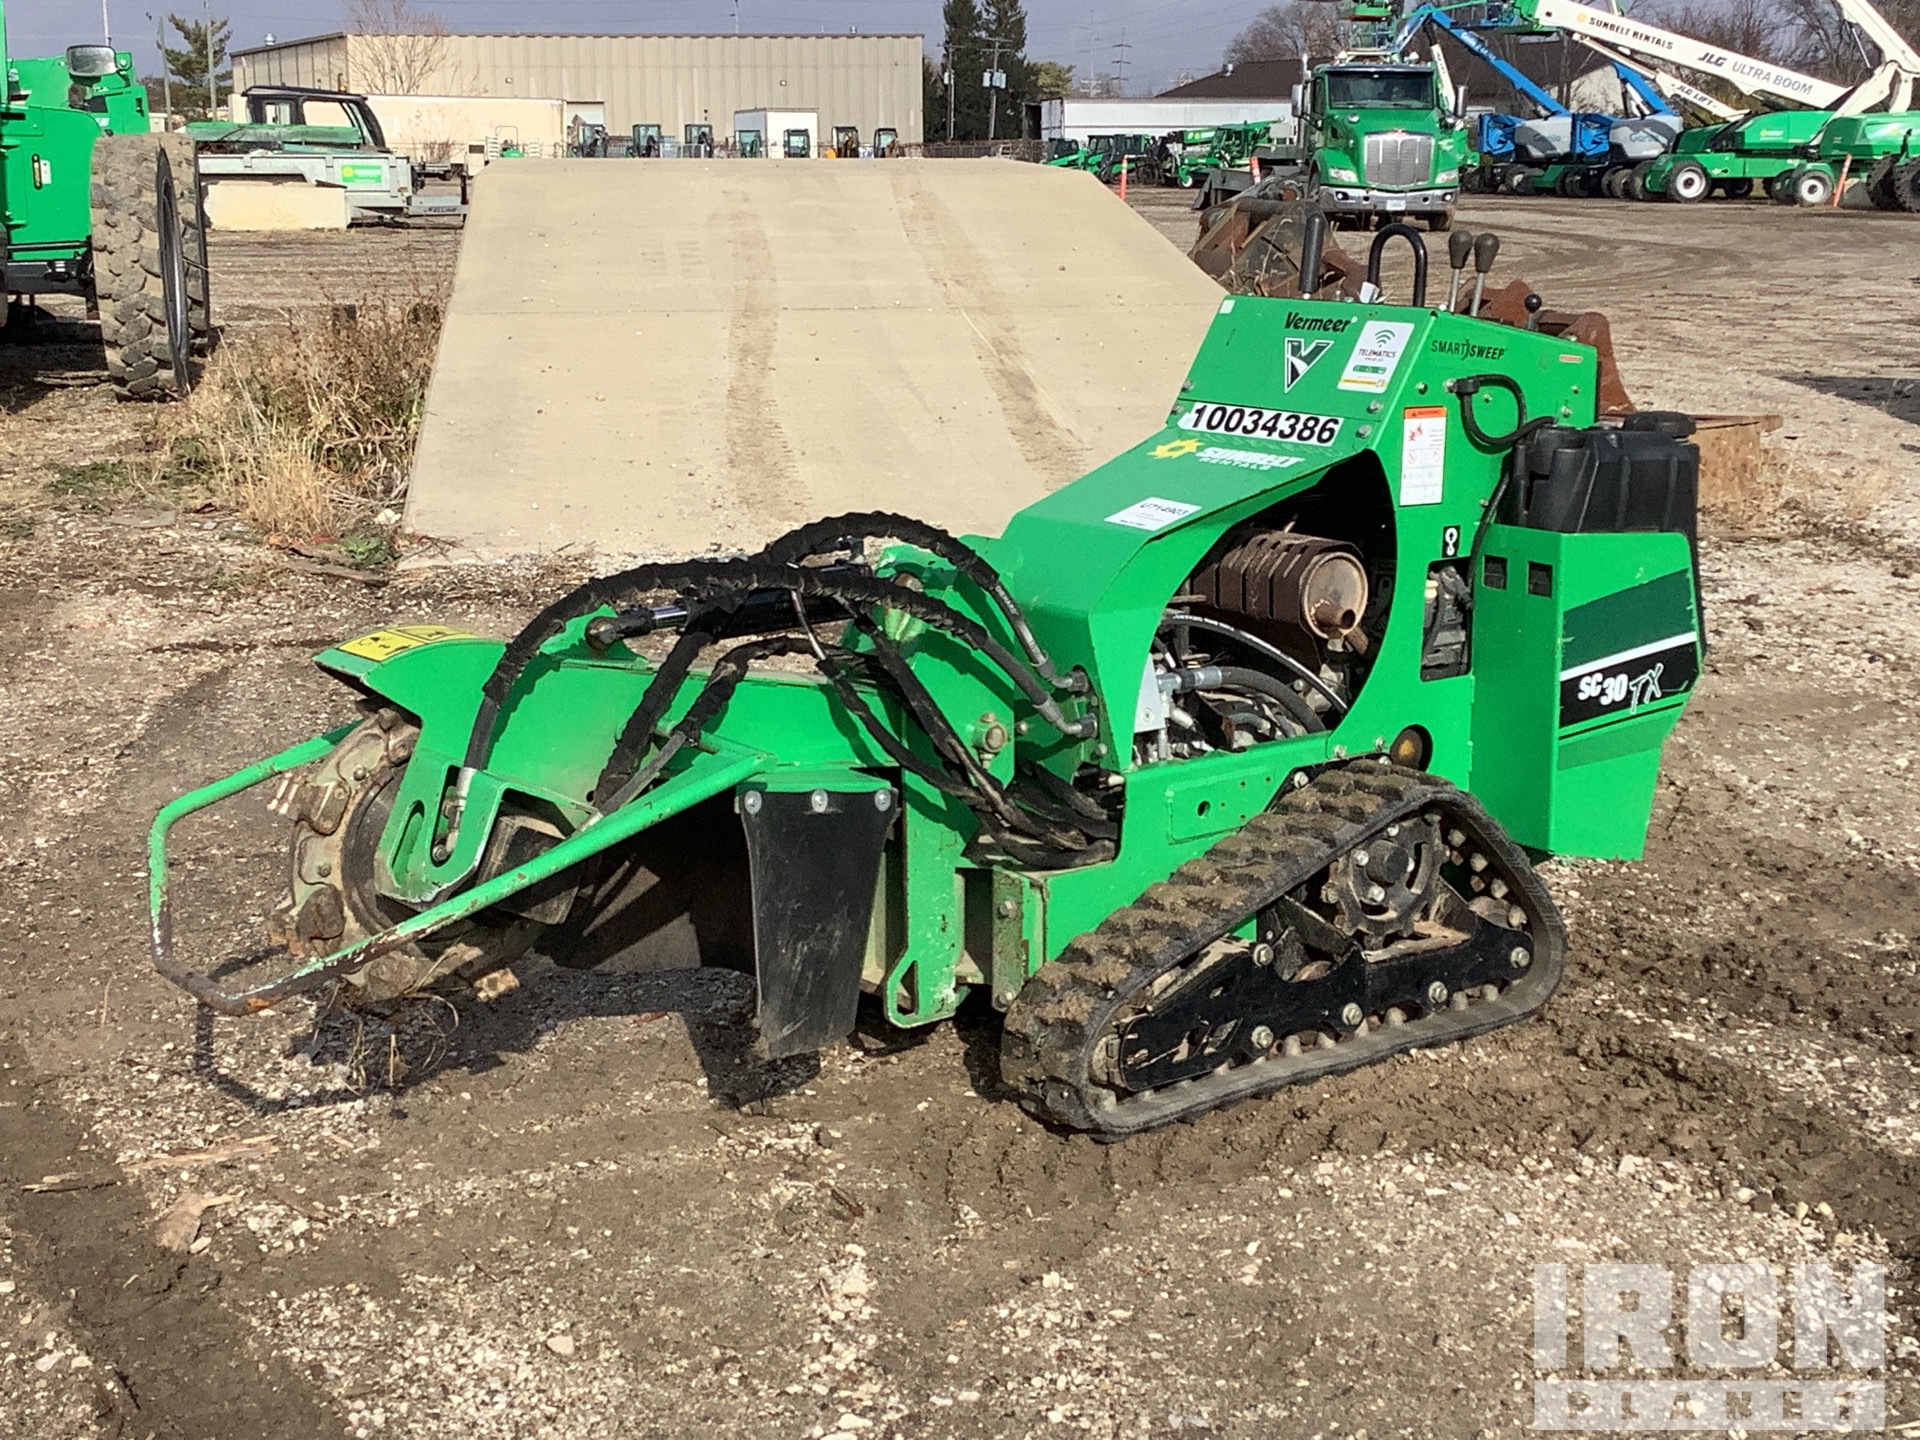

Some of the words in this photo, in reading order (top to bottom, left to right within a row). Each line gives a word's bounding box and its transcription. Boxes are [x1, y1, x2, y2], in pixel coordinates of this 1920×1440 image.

[1589, 17, 1631, 36] SUNBELT
[1632, 30, 1674, 50] RENTALS
[1697, 51, 1728, 68] JLG
[1732, 61, 1771, 84] ULTRA
[1773, 75, 1814, 96] BOOM
[1676, 84, 1694, 97] JLG
[1693, 92, 1714, 109] LIFT
[1284, 311, 1351, 333] Vermeer
[1359, 348, 1397, 358] TELEMATICS
[1431, 339, 1466, 355] SMART
[1469, 344, 1505, 360] SWEEP
[1192, 404, 1340, 444] 10034386
[1195, 446, 1305, 468] SUNBELT
[1198, 457, 1272, 471] RENTALS
